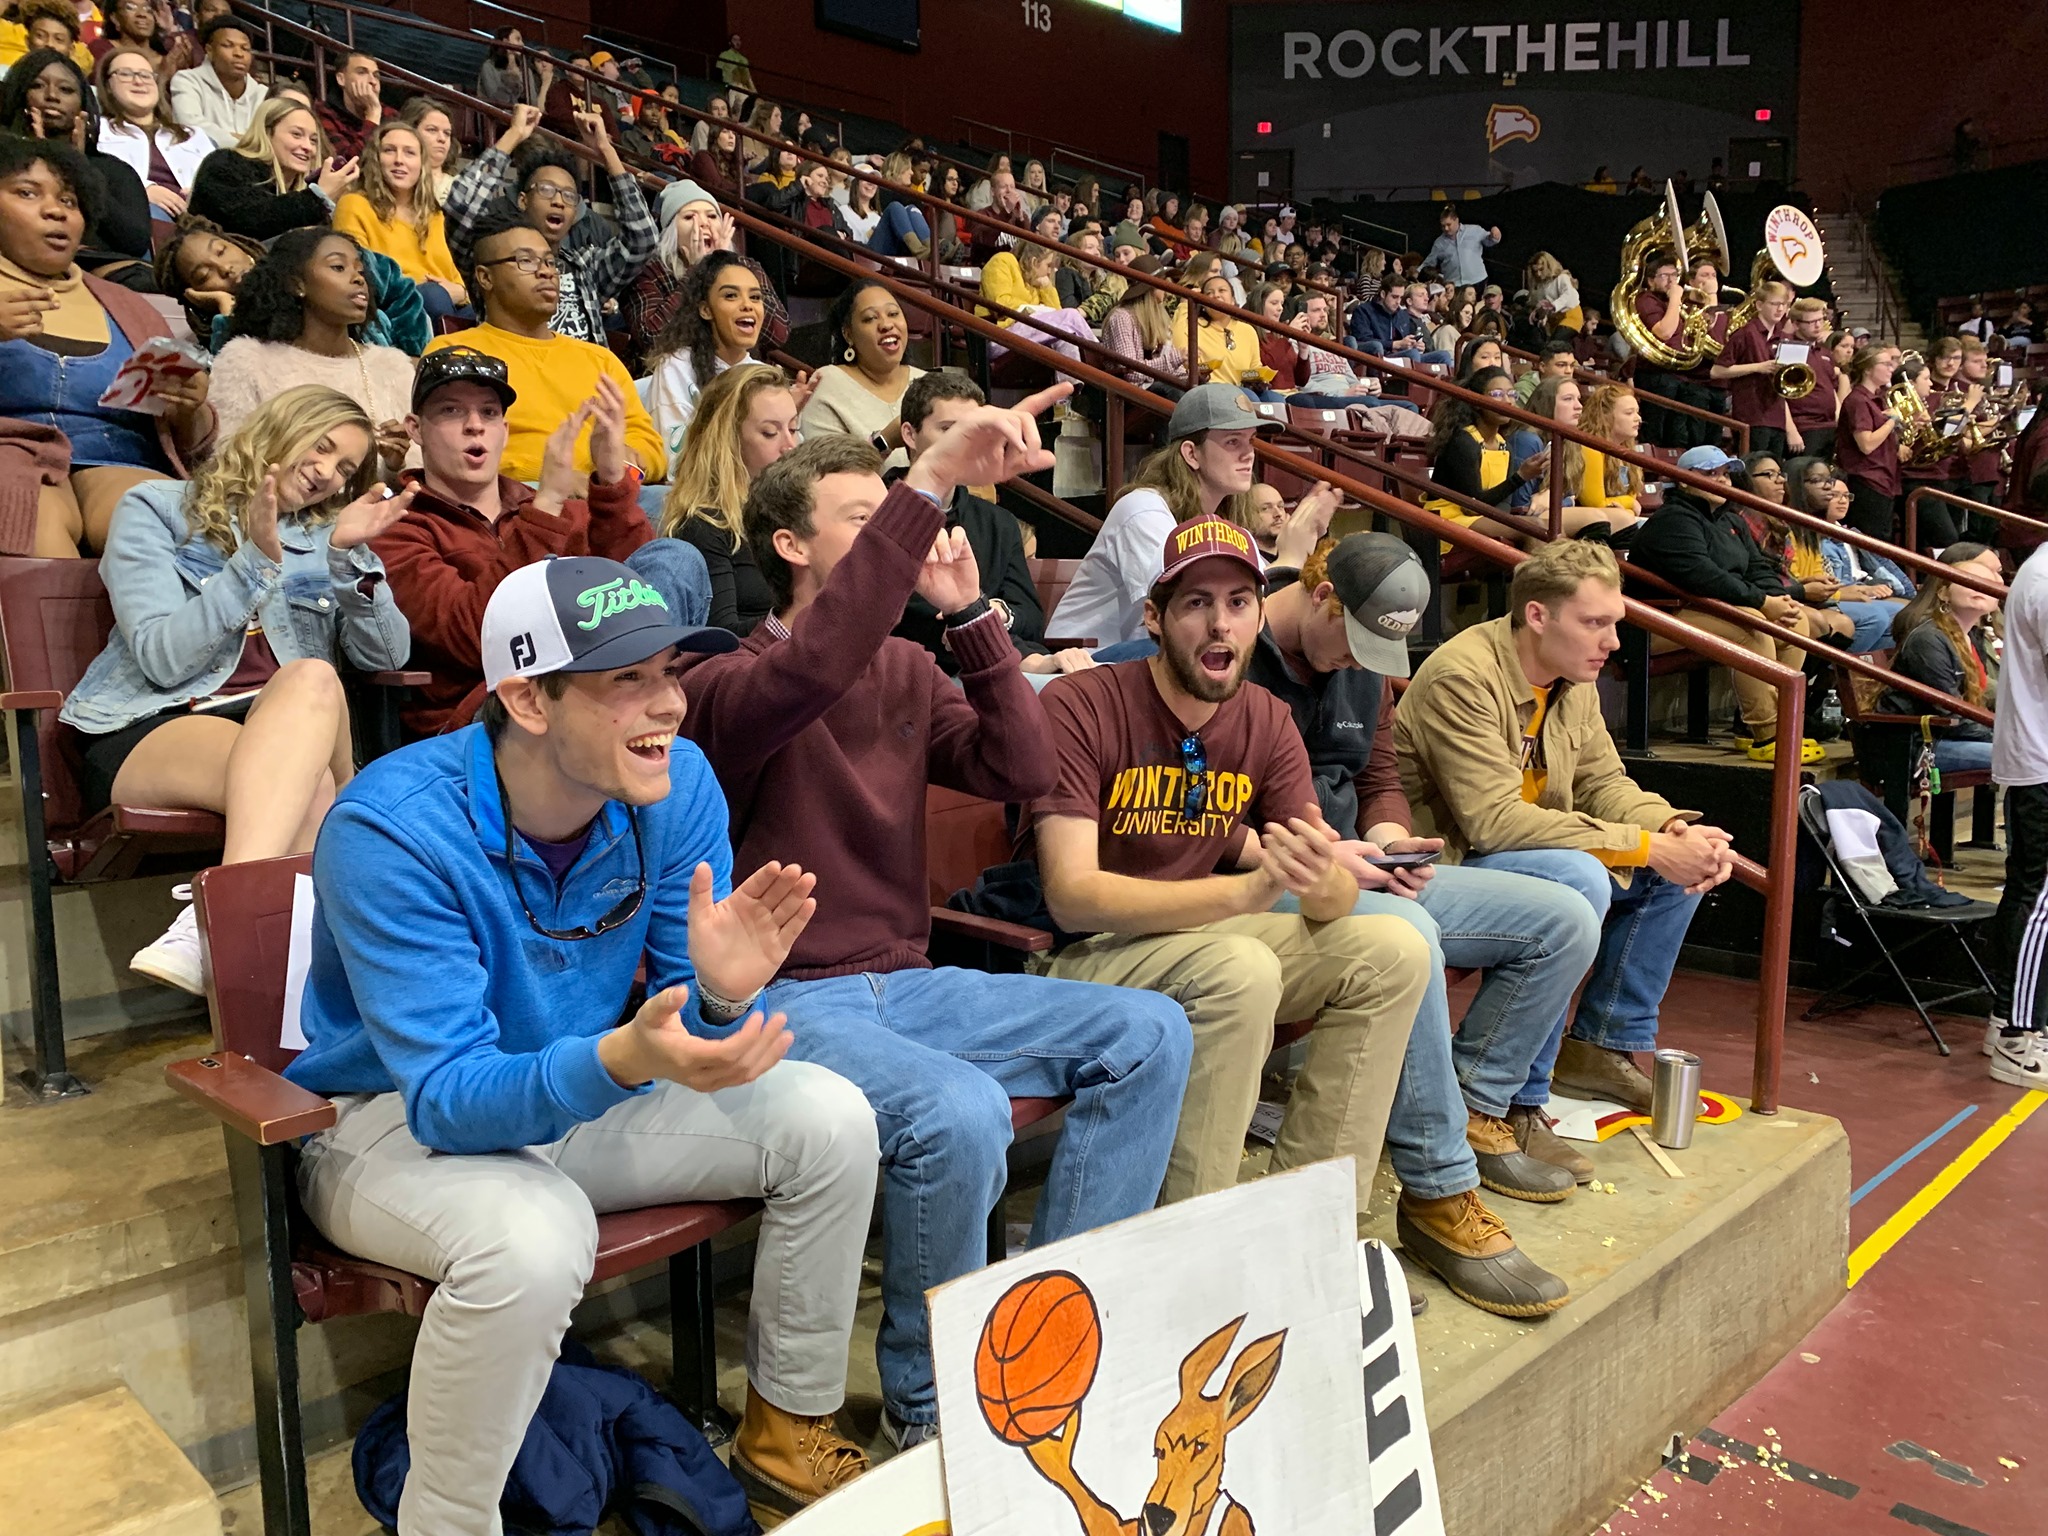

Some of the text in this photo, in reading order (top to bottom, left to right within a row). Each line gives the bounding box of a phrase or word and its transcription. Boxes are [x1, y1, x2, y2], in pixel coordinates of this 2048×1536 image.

[1021, 0, 1052, 33] 113
[1767, 208, 1815, 244] WINTHROP
[1175, 521, 1250, 556] WINTHROP
[509, 631, 537, 671] FJ
[1112, 809, 1234, 838] UNIVERSITY
